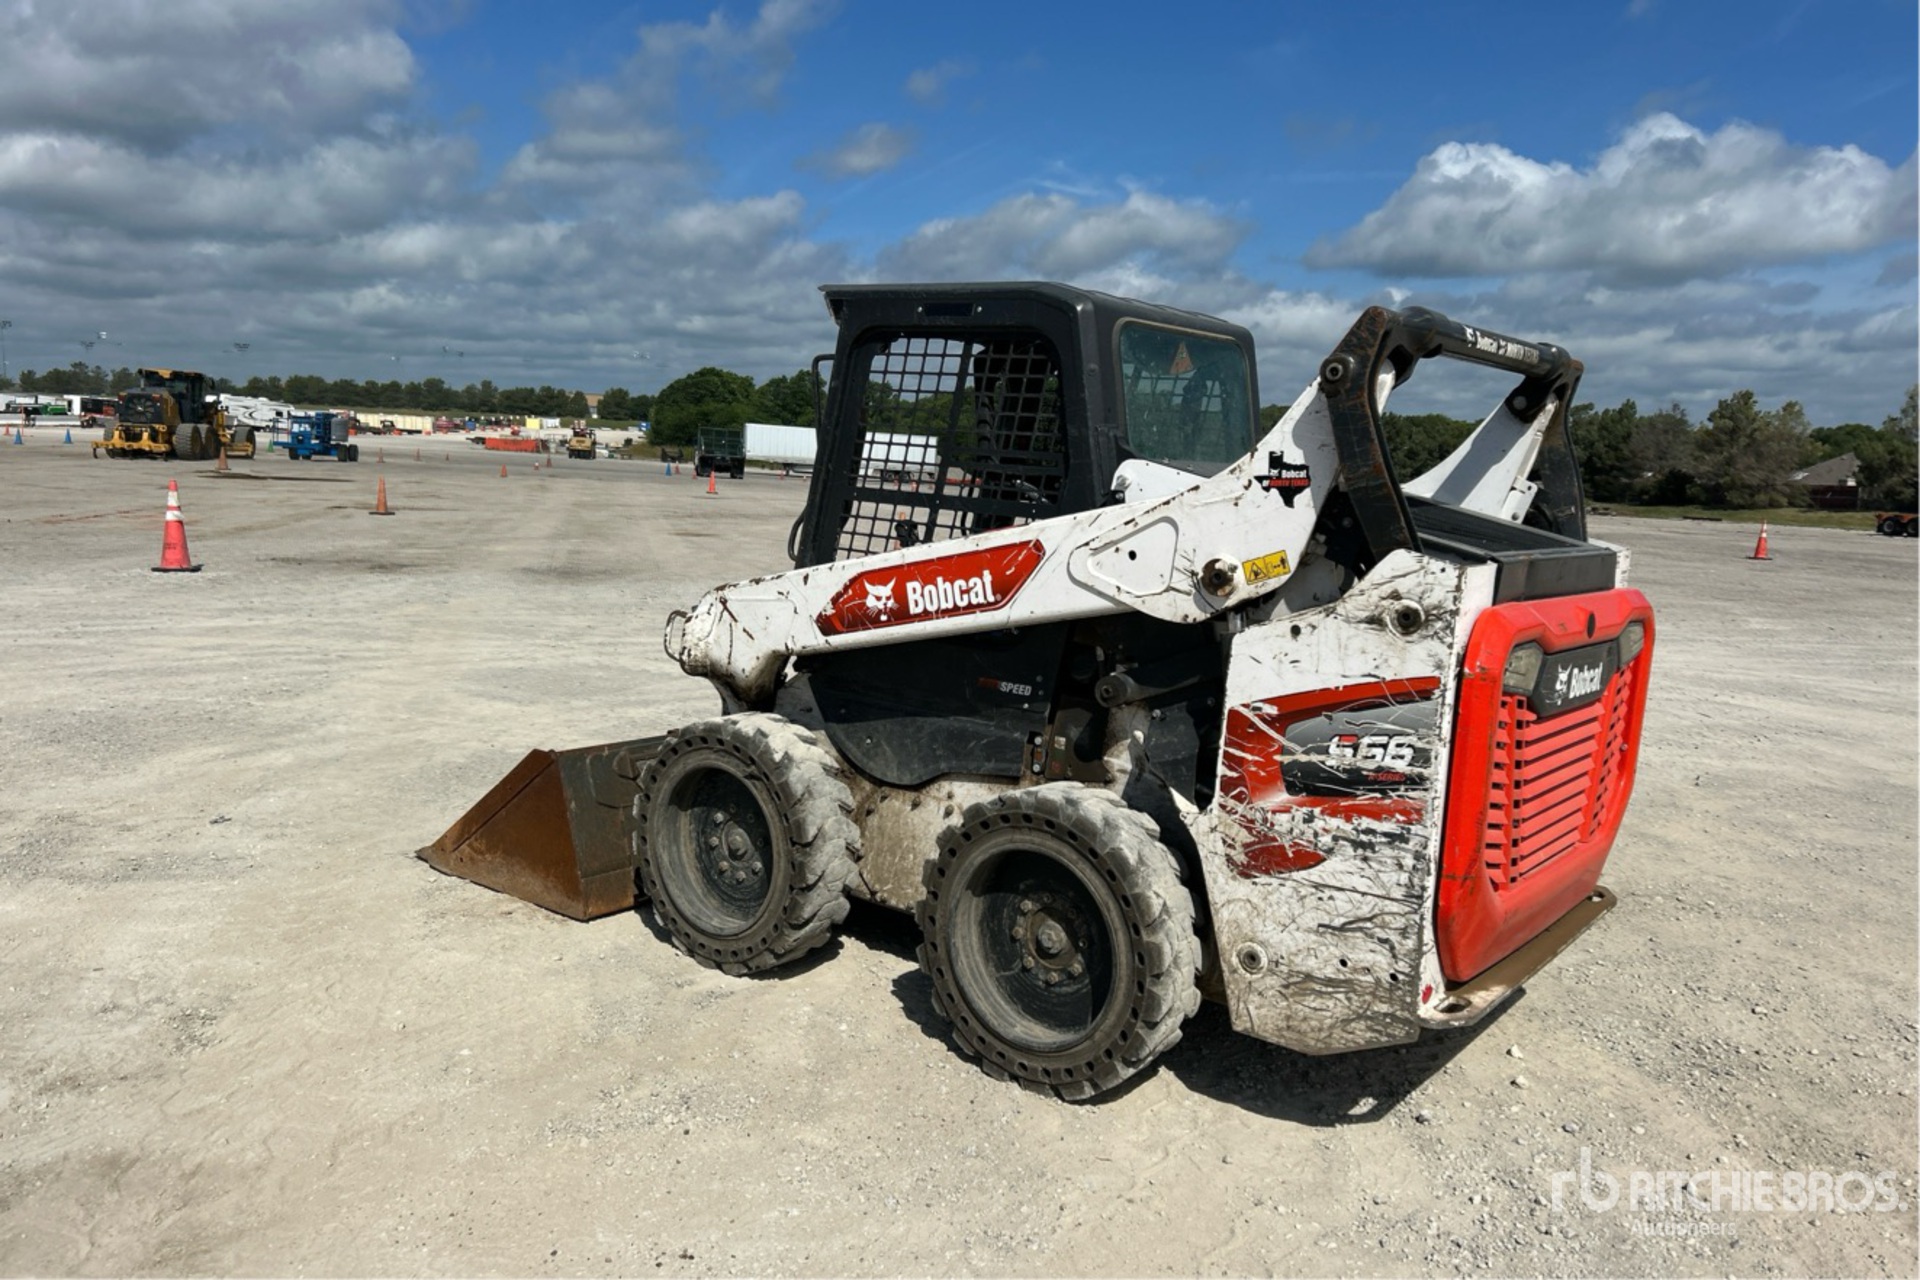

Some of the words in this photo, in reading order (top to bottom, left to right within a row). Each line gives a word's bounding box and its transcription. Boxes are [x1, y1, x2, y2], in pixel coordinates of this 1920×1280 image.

[1281, 469, 1308, 479] Bobcat
[906, 569, 996, 615] Bobcat
[1569, 661, 1604, 699] Bobcat
